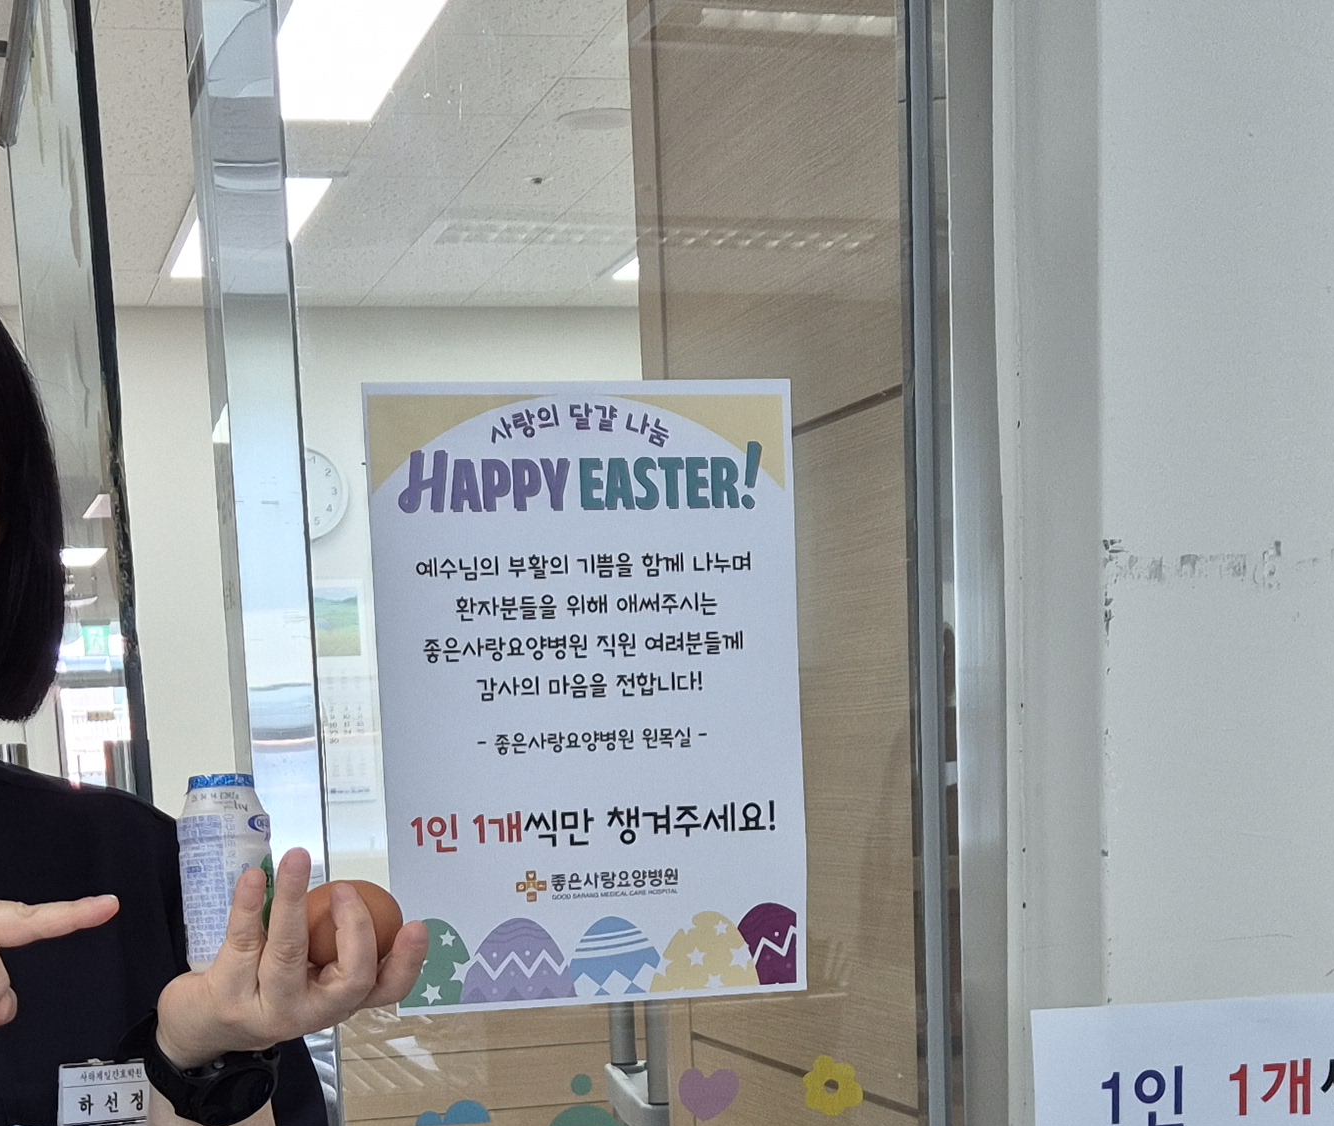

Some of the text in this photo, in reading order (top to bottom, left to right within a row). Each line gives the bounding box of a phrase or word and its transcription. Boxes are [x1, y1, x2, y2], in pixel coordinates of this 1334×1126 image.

[491, 403, 669, 447] 사랑의 달걀 나눔
[398, 440, 762, 513] HAPPY EASTER!
[416, 551, 751, 581] 예수님의 부활의 기쁨을 함께 나누며
[455, 593, 717, 621] 환자분들을 위해 애써주시는
[423, 631, 743, 663] 좋은사랑요양병원 직원 여러분들께
[476, 670, 702, 701] 감사의 마음을 전합니다!
[494, 730, 634, 755] 좋은사랑요양병원
[642, 728, 691, 749] 원목실
[410, 801, 776, 853] 1인 1개씩만 챙겨주세요!
[552, 868, 678, 892] 좋은사랑요양병원
[78, 1089, 143, 1116] 하 선 정
